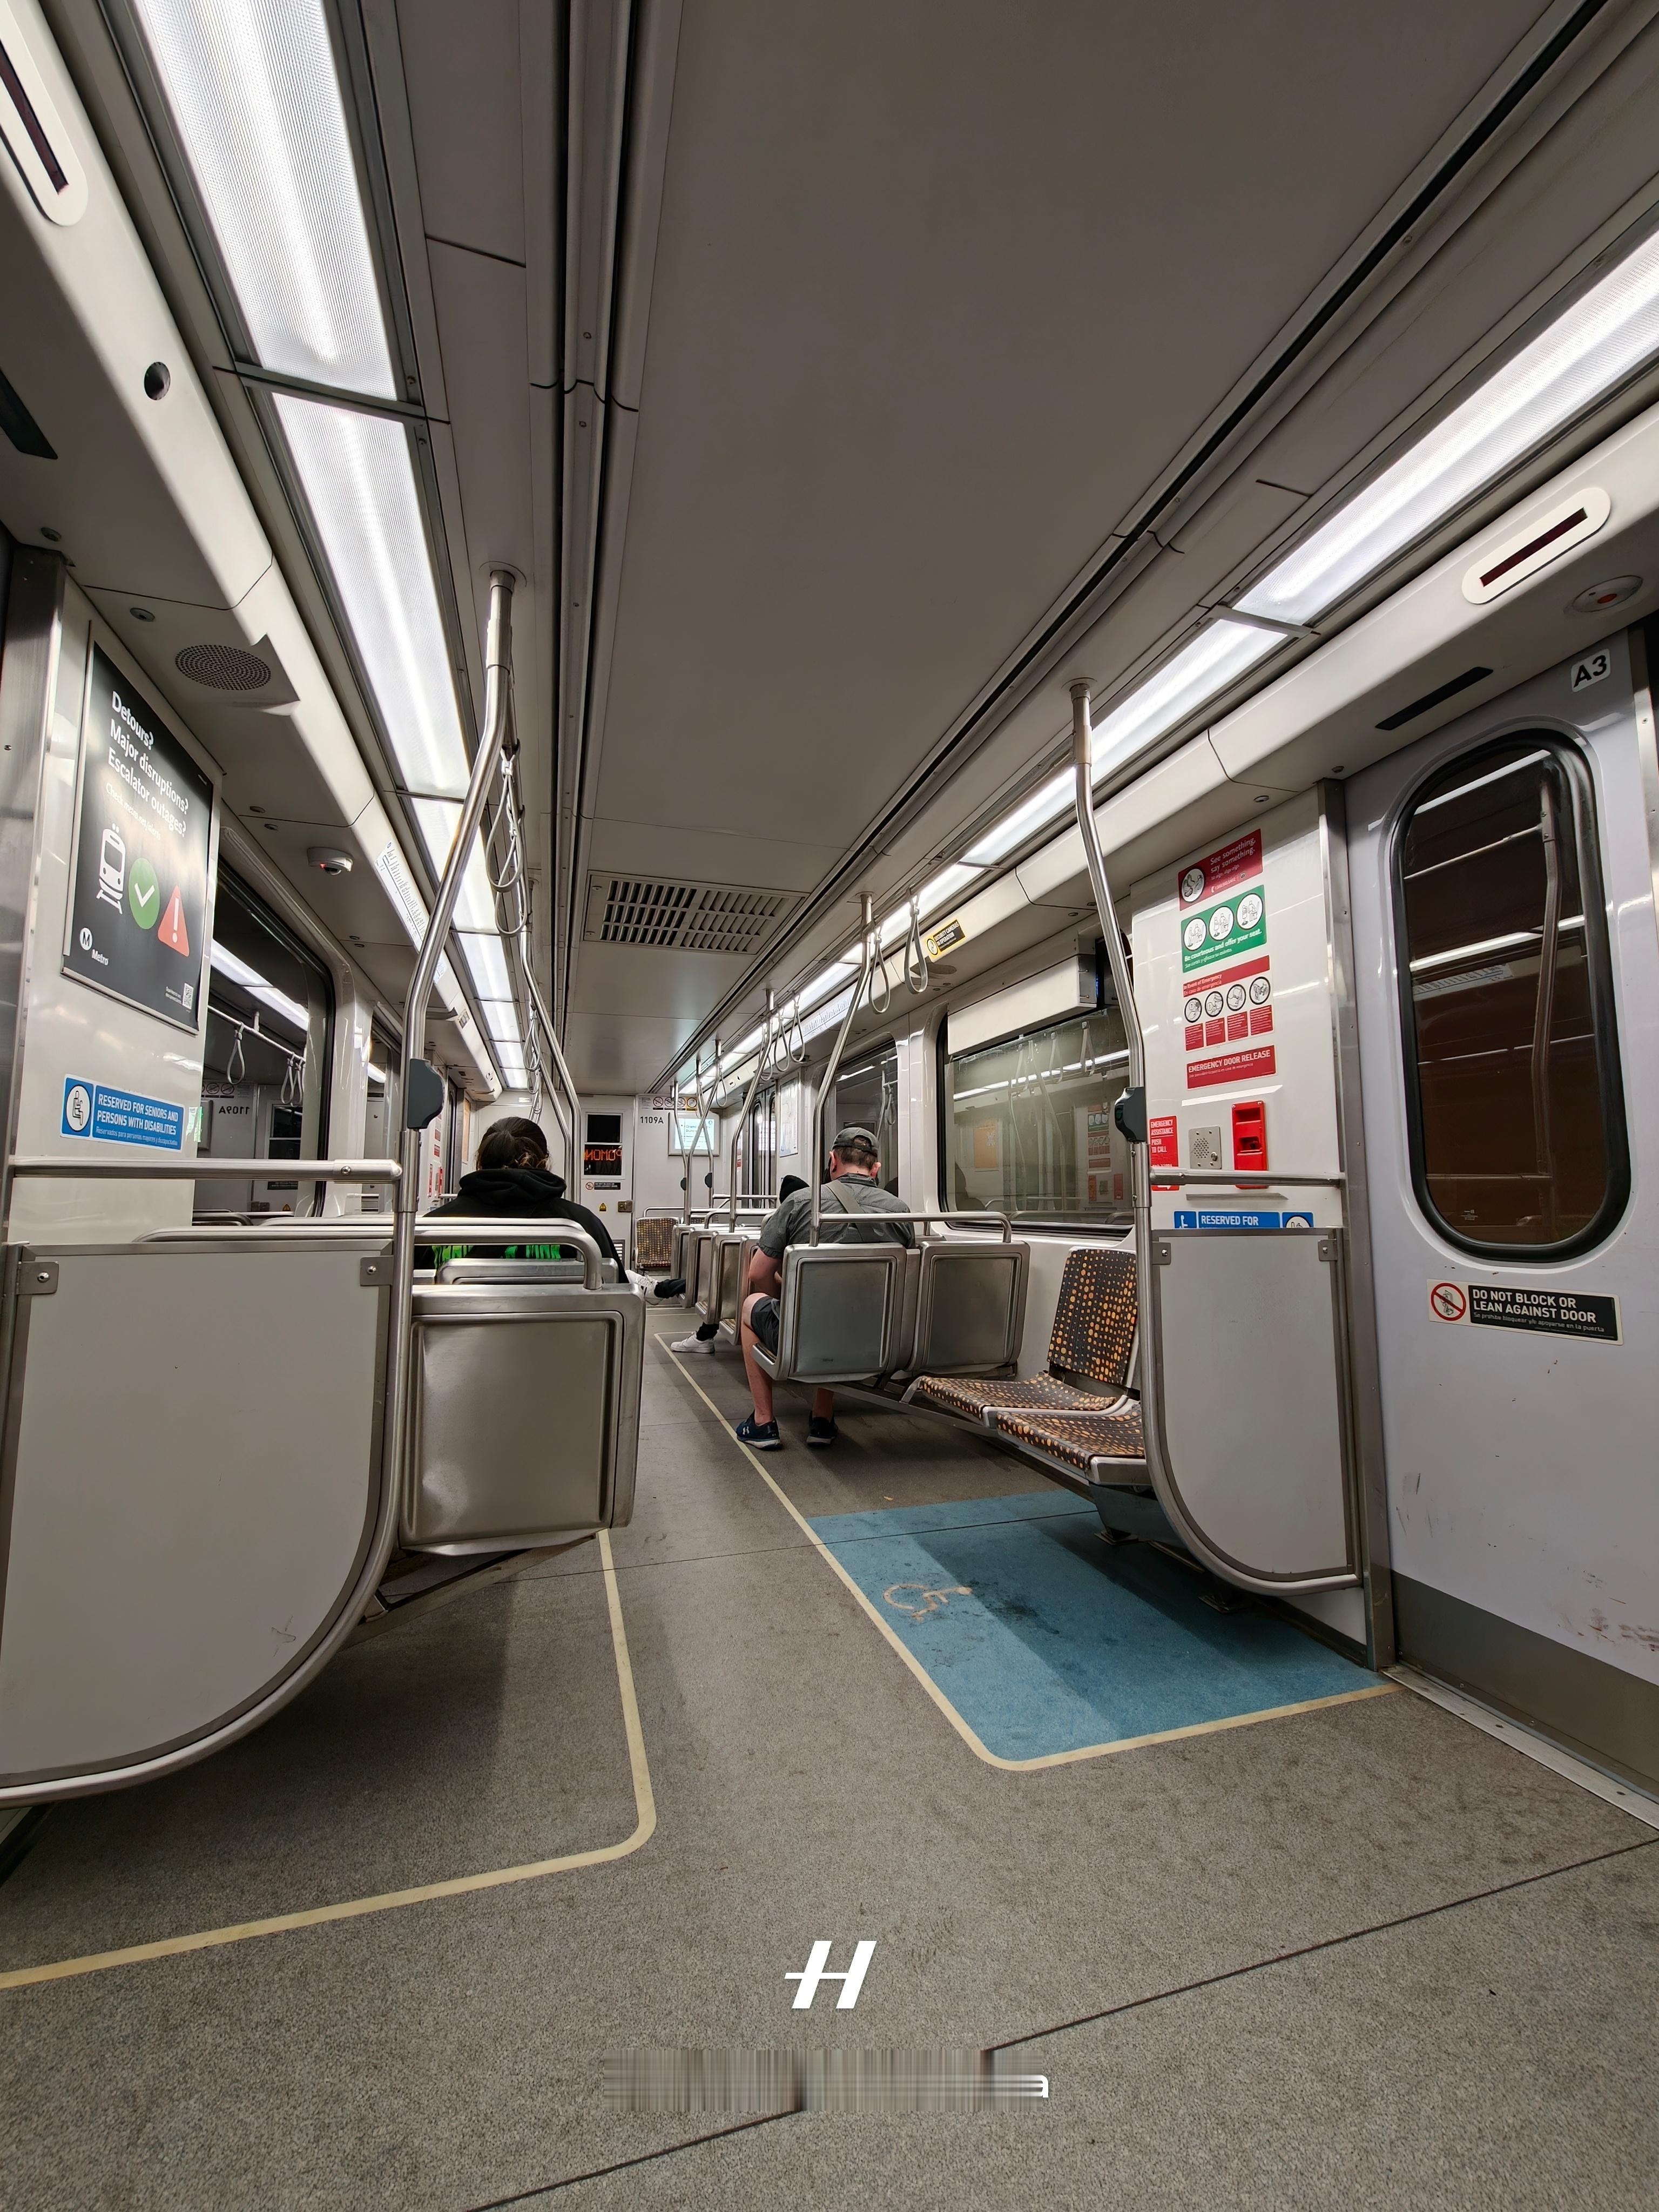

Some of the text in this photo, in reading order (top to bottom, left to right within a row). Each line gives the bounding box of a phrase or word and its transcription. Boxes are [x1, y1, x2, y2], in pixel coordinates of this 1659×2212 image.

[1574, 655, 1607, 687] A3
[112, 691, 154, 750] Detours?
[110, 718, 188, 814] Major disruptions?
[106, 783, 123, 806] Check
[108, 746, 186, 837] Escalator outages?
[1210, 838, 1256, 865] See something,
[1211, 864, 1220, 873] say
[1222, 847, 1256, 867] something.
[1191, 947, 1215, 959] courteous
[1215, 942, 1224, 950] and
[1225, 938, 1237, 947] offer
[1237, 934, 1249, 943] your
[1249, 929, 1262, 938] seat.
[91, 949, 109, 966] Metro
[1201, 974, 1222, 984] Emergency
[1188, 1049, 1271, 1073] EMERGENCY DOOR RELEASE
[98, 1094, 178, 1122] RESERVED FOR SENIORS AND
[97, 1110, 177, 1135] PERSONS WITH DISABILITIES
[1150, 1119, 1173, 1128] EMERGENCY
[1151, 1127, 1174, 1135] ASSISTANCE
[1201, 1215, 1259, 1226] RESERVED FOR
[1473, 1289, 1577, 1309] DO NOT BLOCK OR
[1473, 1301, 1597, 1323] LEAN AGAINST DOOR
